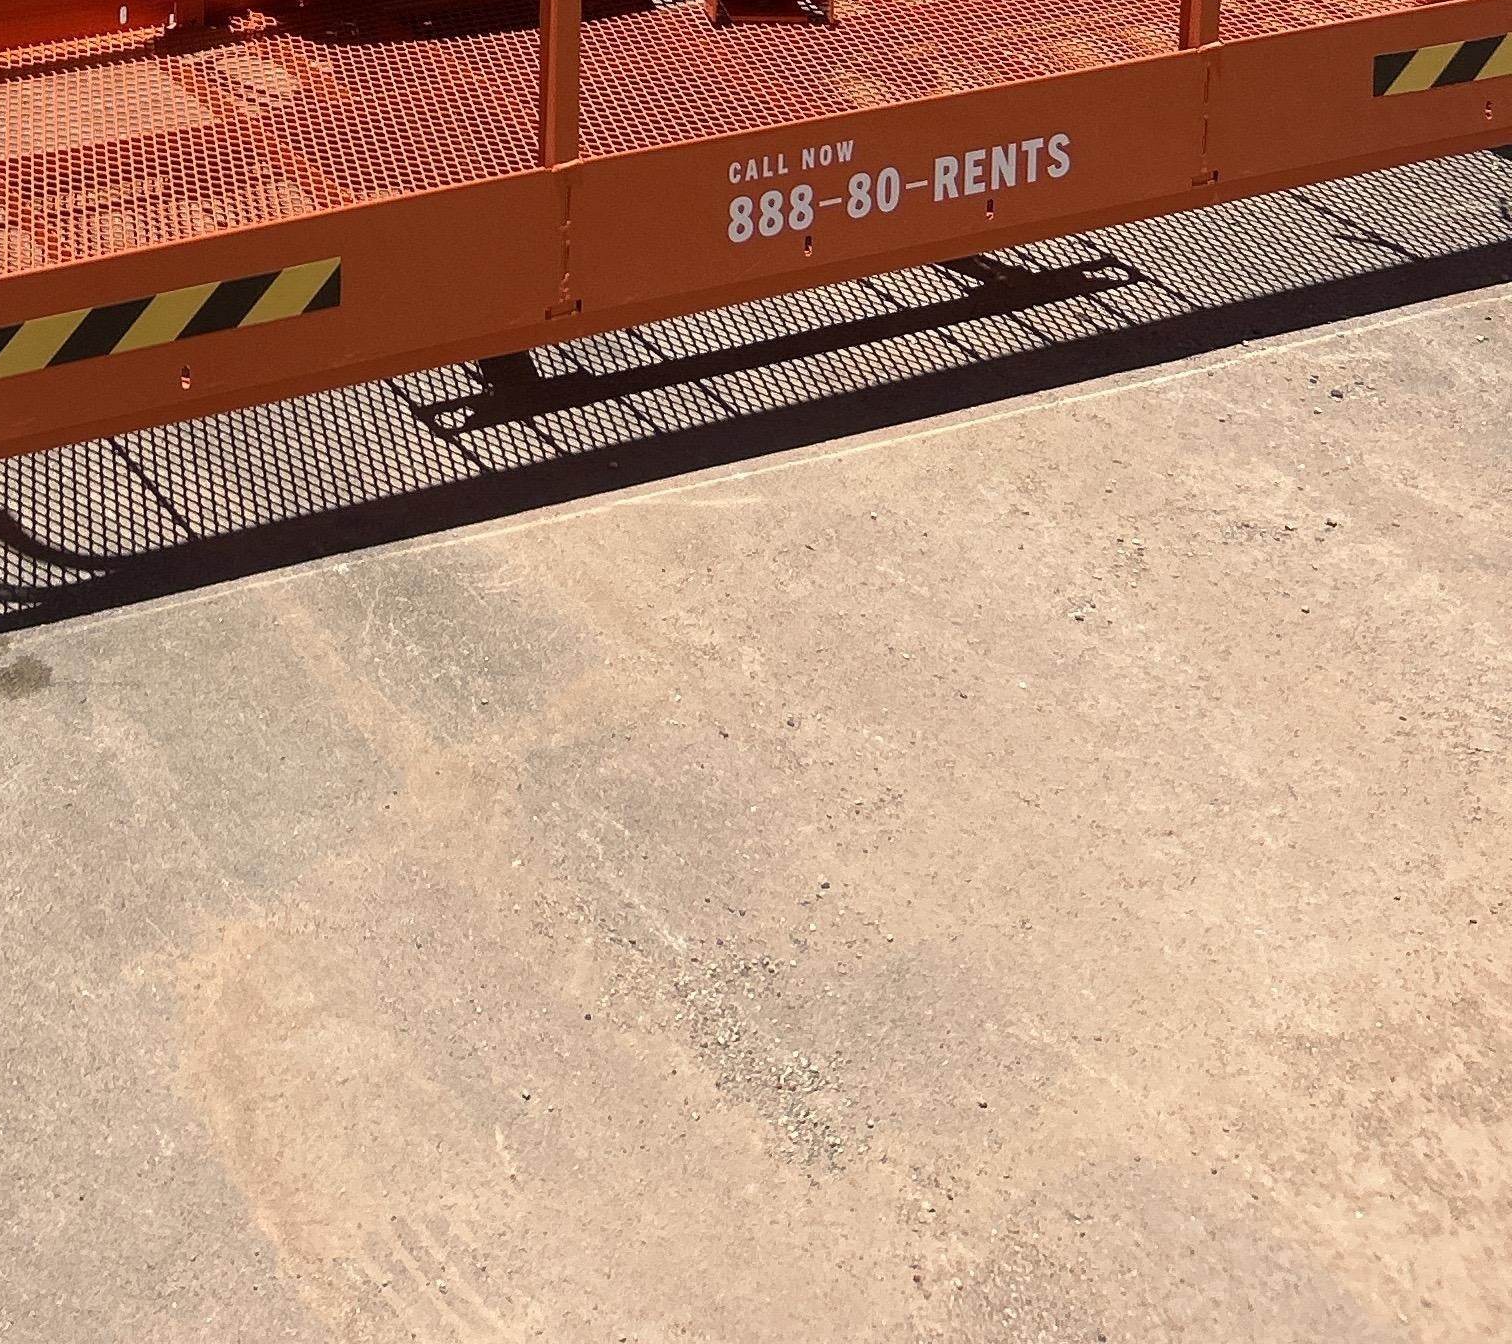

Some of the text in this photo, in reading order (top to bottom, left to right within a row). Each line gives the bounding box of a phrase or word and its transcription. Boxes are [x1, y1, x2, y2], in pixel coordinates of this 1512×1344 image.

[726, 131, 1073, 244] 888-80-RENTS
[728, 139, 855, 185] CALL NOW
